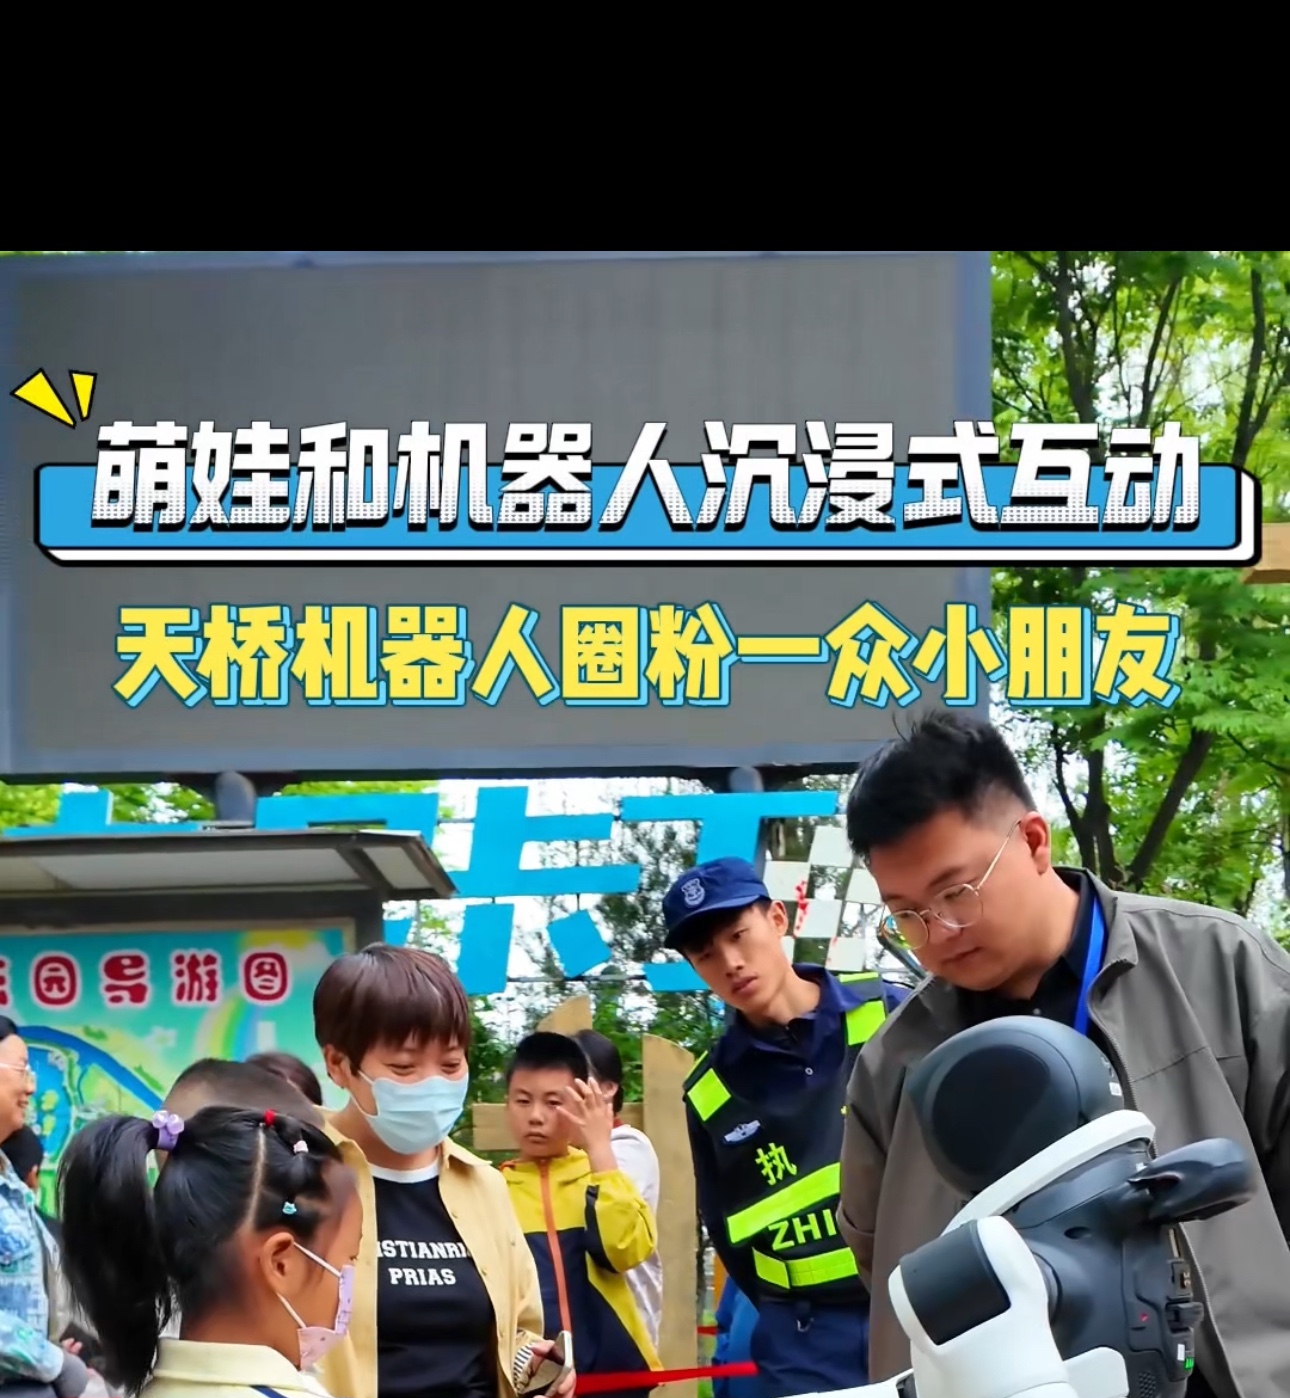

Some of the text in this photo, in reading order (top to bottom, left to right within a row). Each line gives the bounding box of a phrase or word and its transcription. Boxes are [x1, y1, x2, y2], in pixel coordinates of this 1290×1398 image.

[0, 951, 289, 1007] 园导游图
[768, 1208, 837, 1251] ZHI
[377, 1239, 472, 1260] ISTIANRI
[388, 1267, 457, 1286] PRIAS
